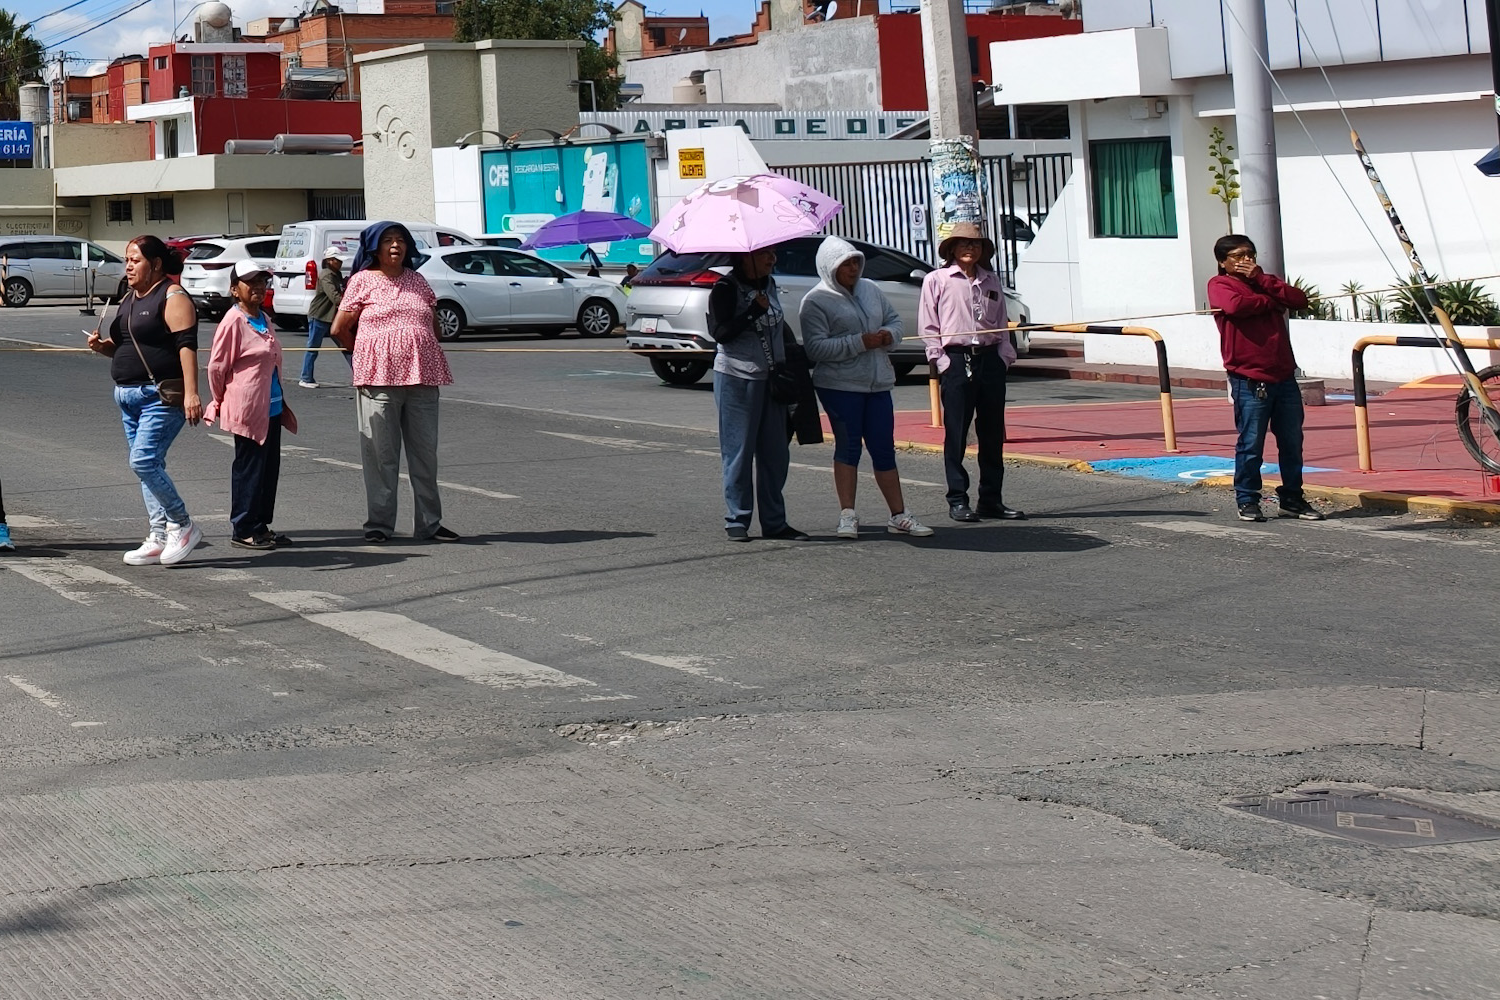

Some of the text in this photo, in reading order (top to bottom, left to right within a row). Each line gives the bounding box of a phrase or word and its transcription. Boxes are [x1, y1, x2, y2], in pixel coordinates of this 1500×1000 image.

[774, 119, 827, 134] DE
[2, 144, 31, 155] 6147
[489, 164, 509, 188] CFE
